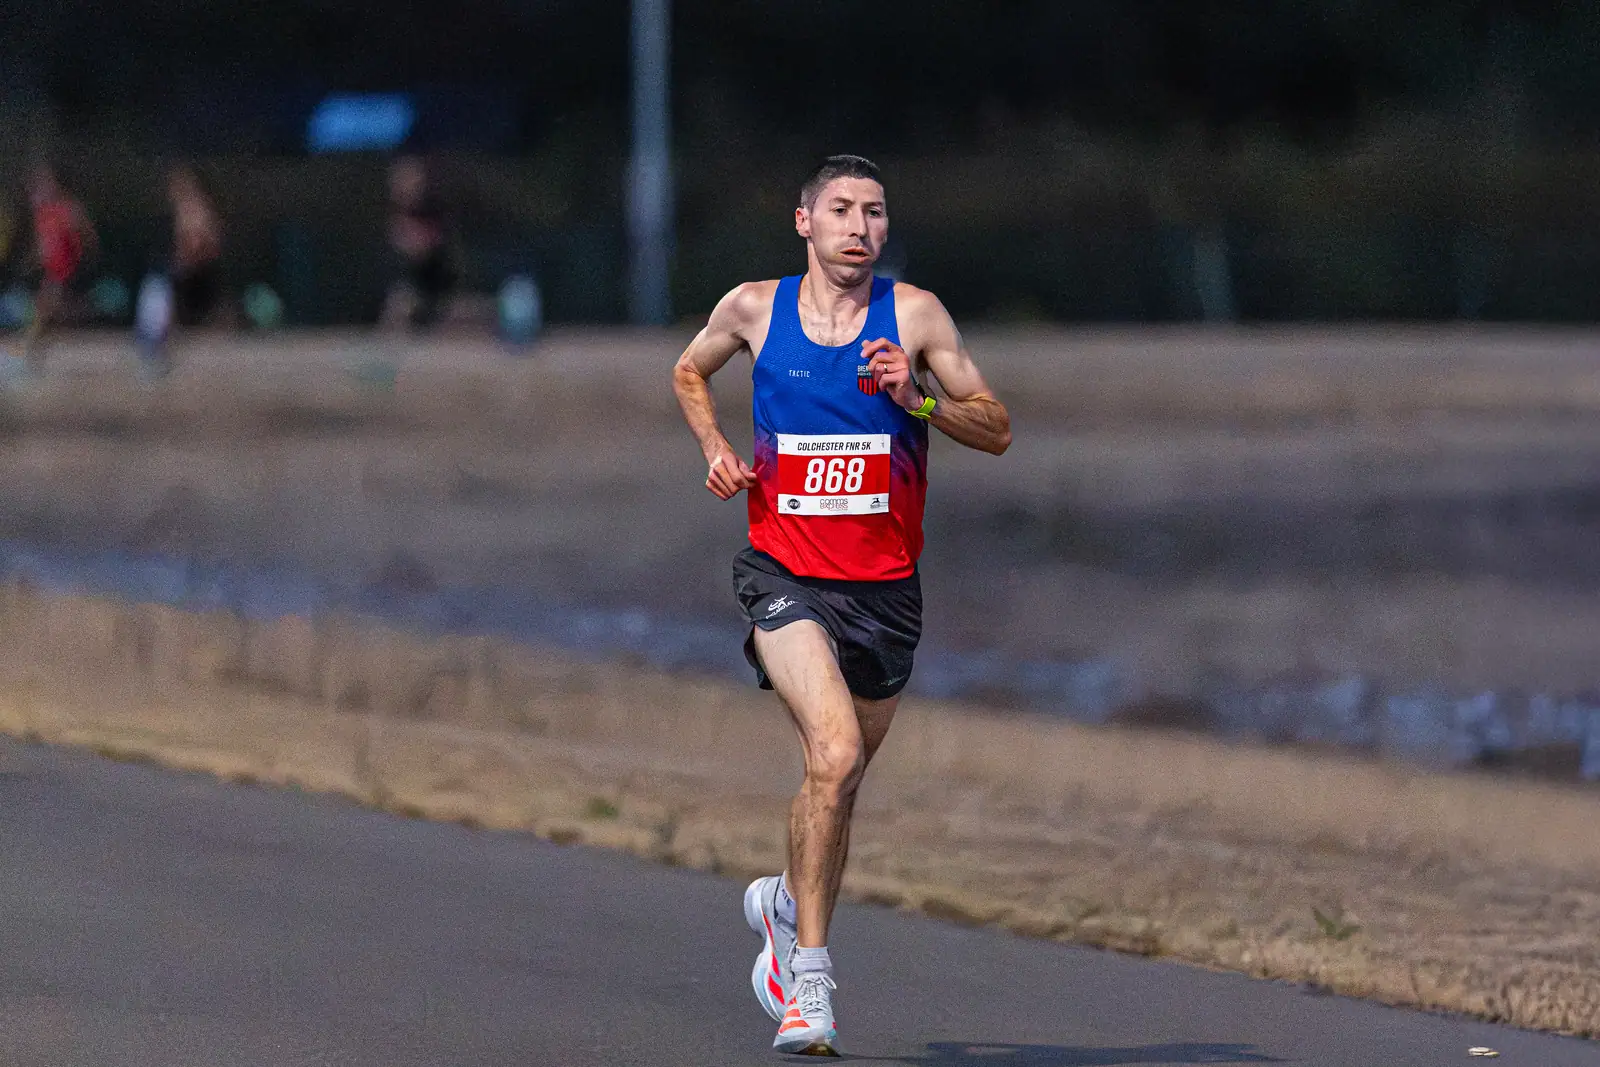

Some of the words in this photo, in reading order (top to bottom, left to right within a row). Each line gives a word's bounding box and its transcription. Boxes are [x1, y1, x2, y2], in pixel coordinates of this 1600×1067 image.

[788, 369, 811, 378] TACTIC
[797, 441, 845, 451] COLCHESTER
[845, 441, 861, 451] FNR
[861, 441, 872, 451] 5K
[804, 457, 865, 493] 868
